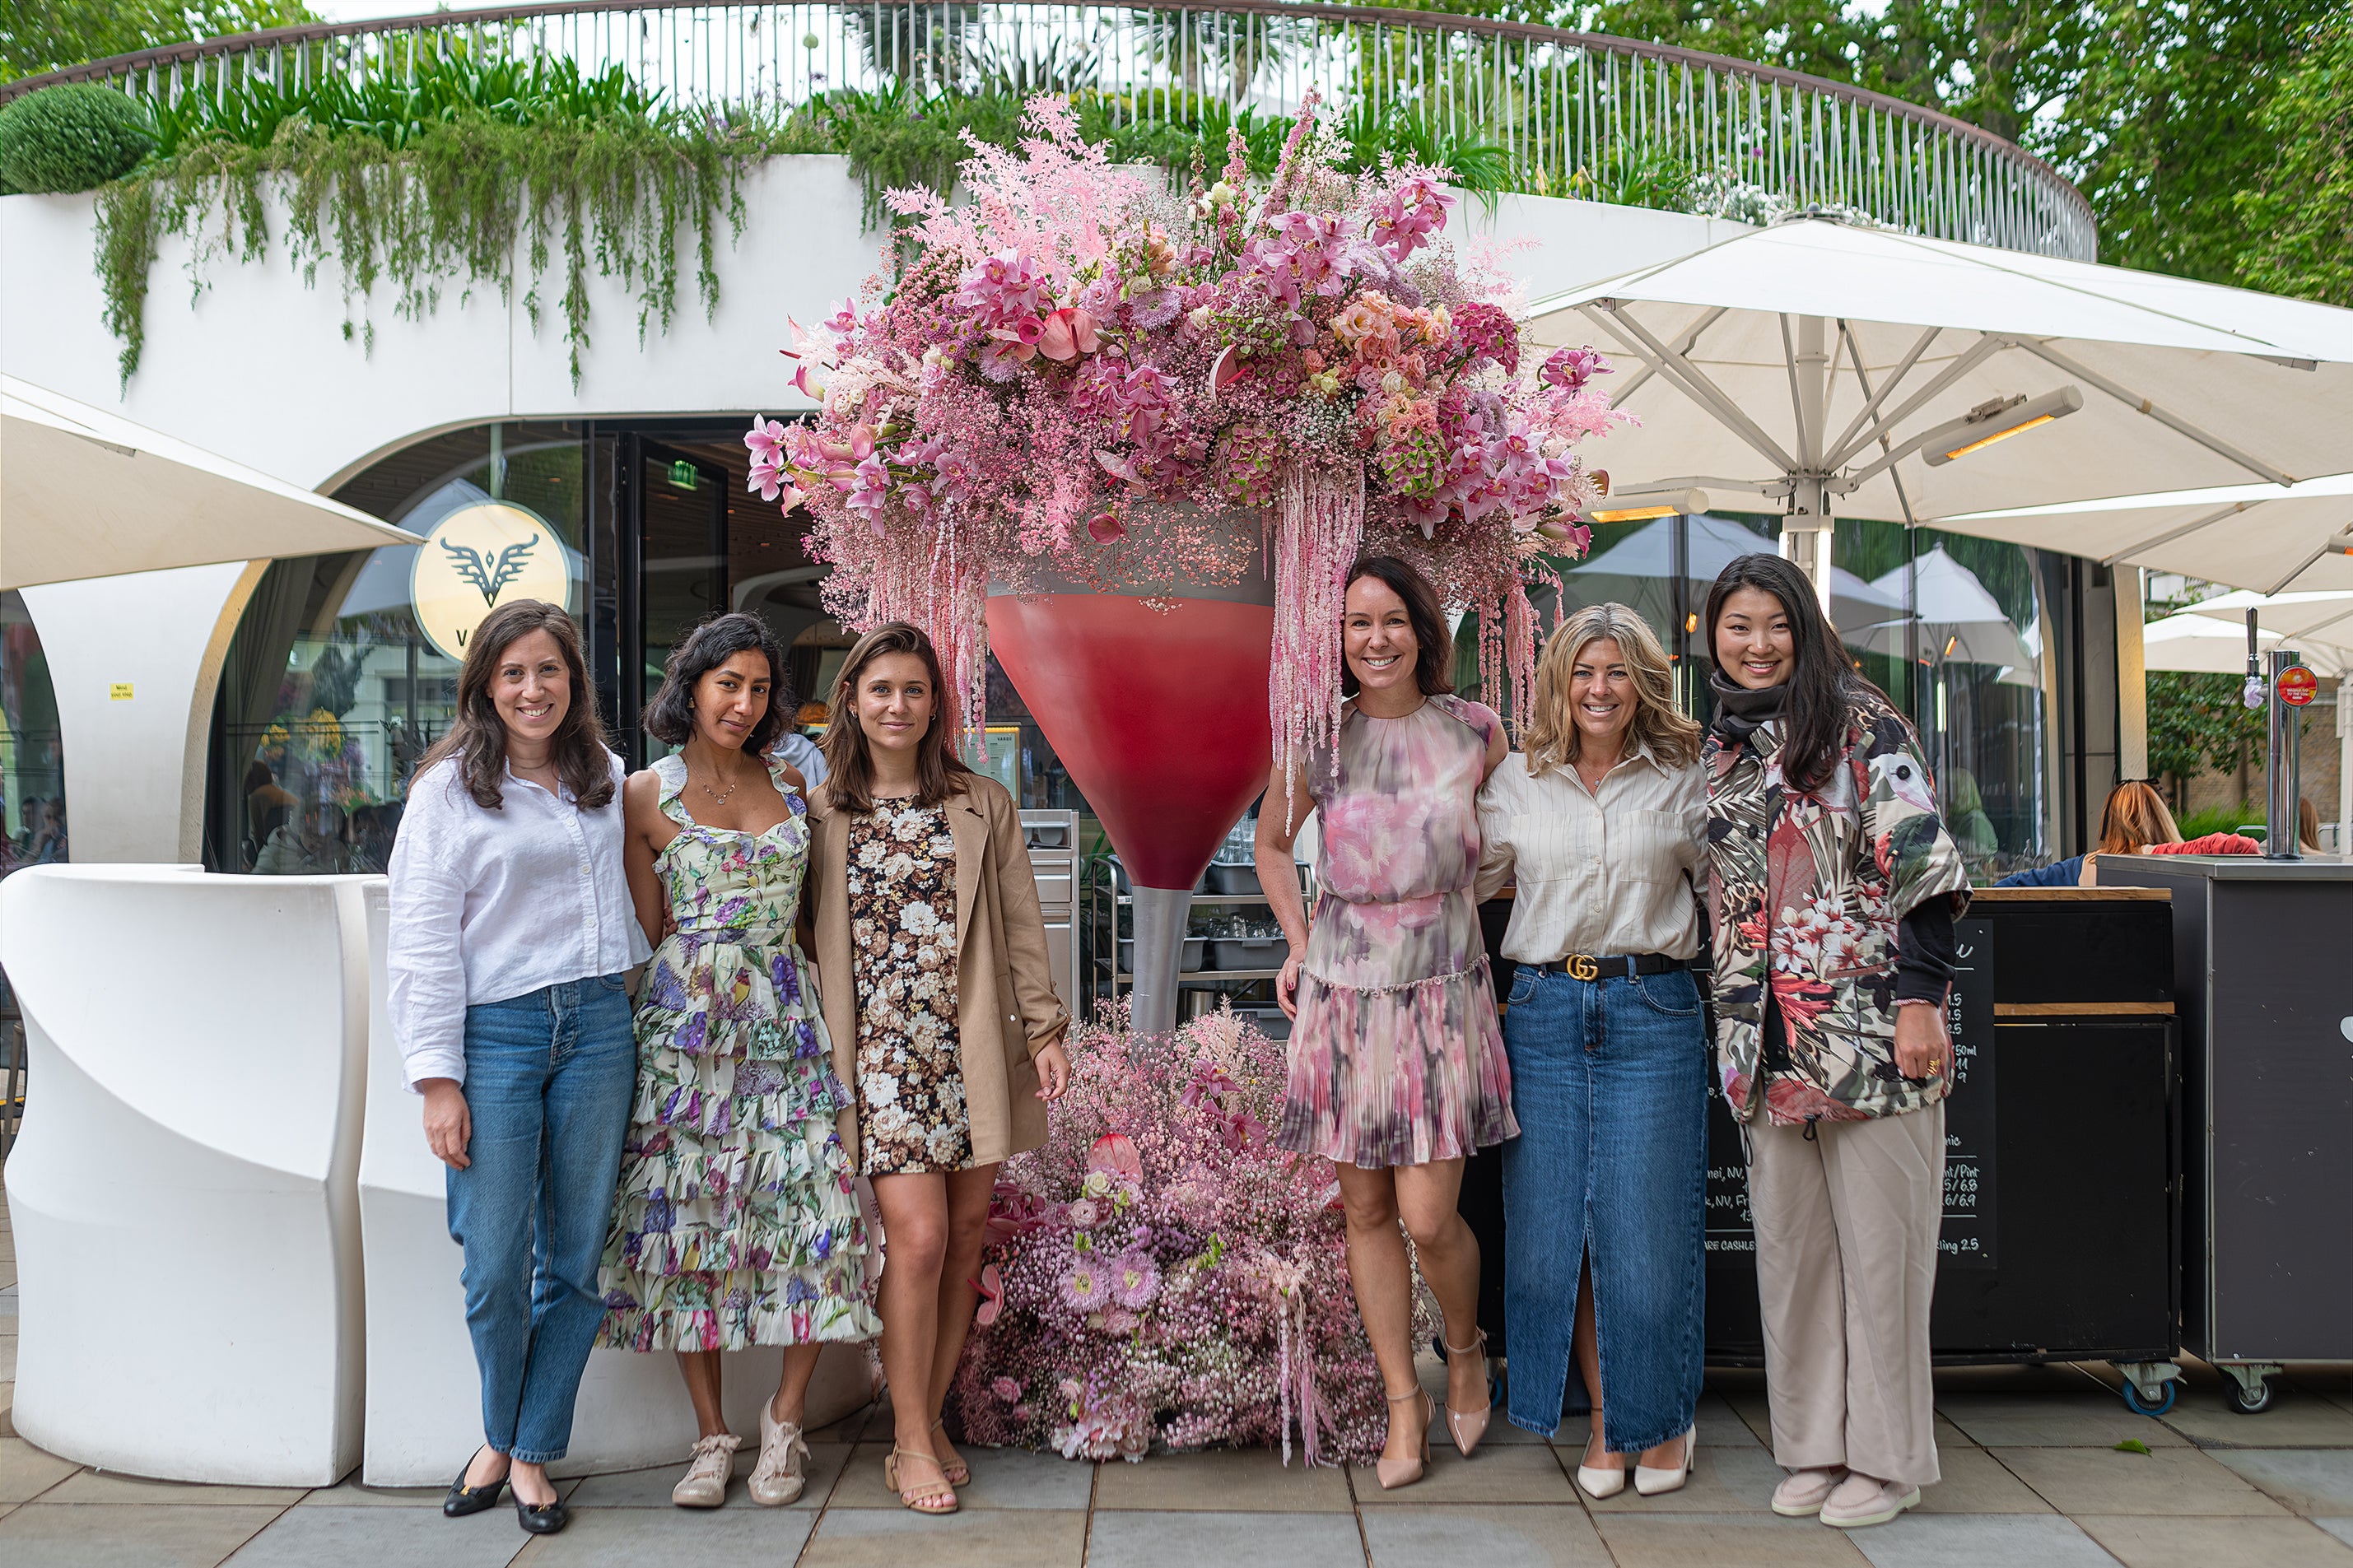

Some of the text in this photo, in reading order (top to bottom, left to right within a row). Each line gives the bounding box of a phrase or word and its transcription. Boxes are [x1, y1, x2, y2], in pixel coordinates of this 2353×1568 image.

[1955, 1058, 1968, 1070] 11
[1945, 1134, 1961, 1146] nic
[1707, 1167, 1726, 1182] nei,
[1943, 1164, 1980, 1179] nt/Pint
[1942, 1178, 1978, 1192] .5/6.8
[1736, 1194, 1750, 1207] Fr
[1941, 1193, 1976, 1207] .6/6.9
[1721, 1240, 1756, 1251] CASHLE
[1936, 1238, 1979, 1255] ling 2.5
